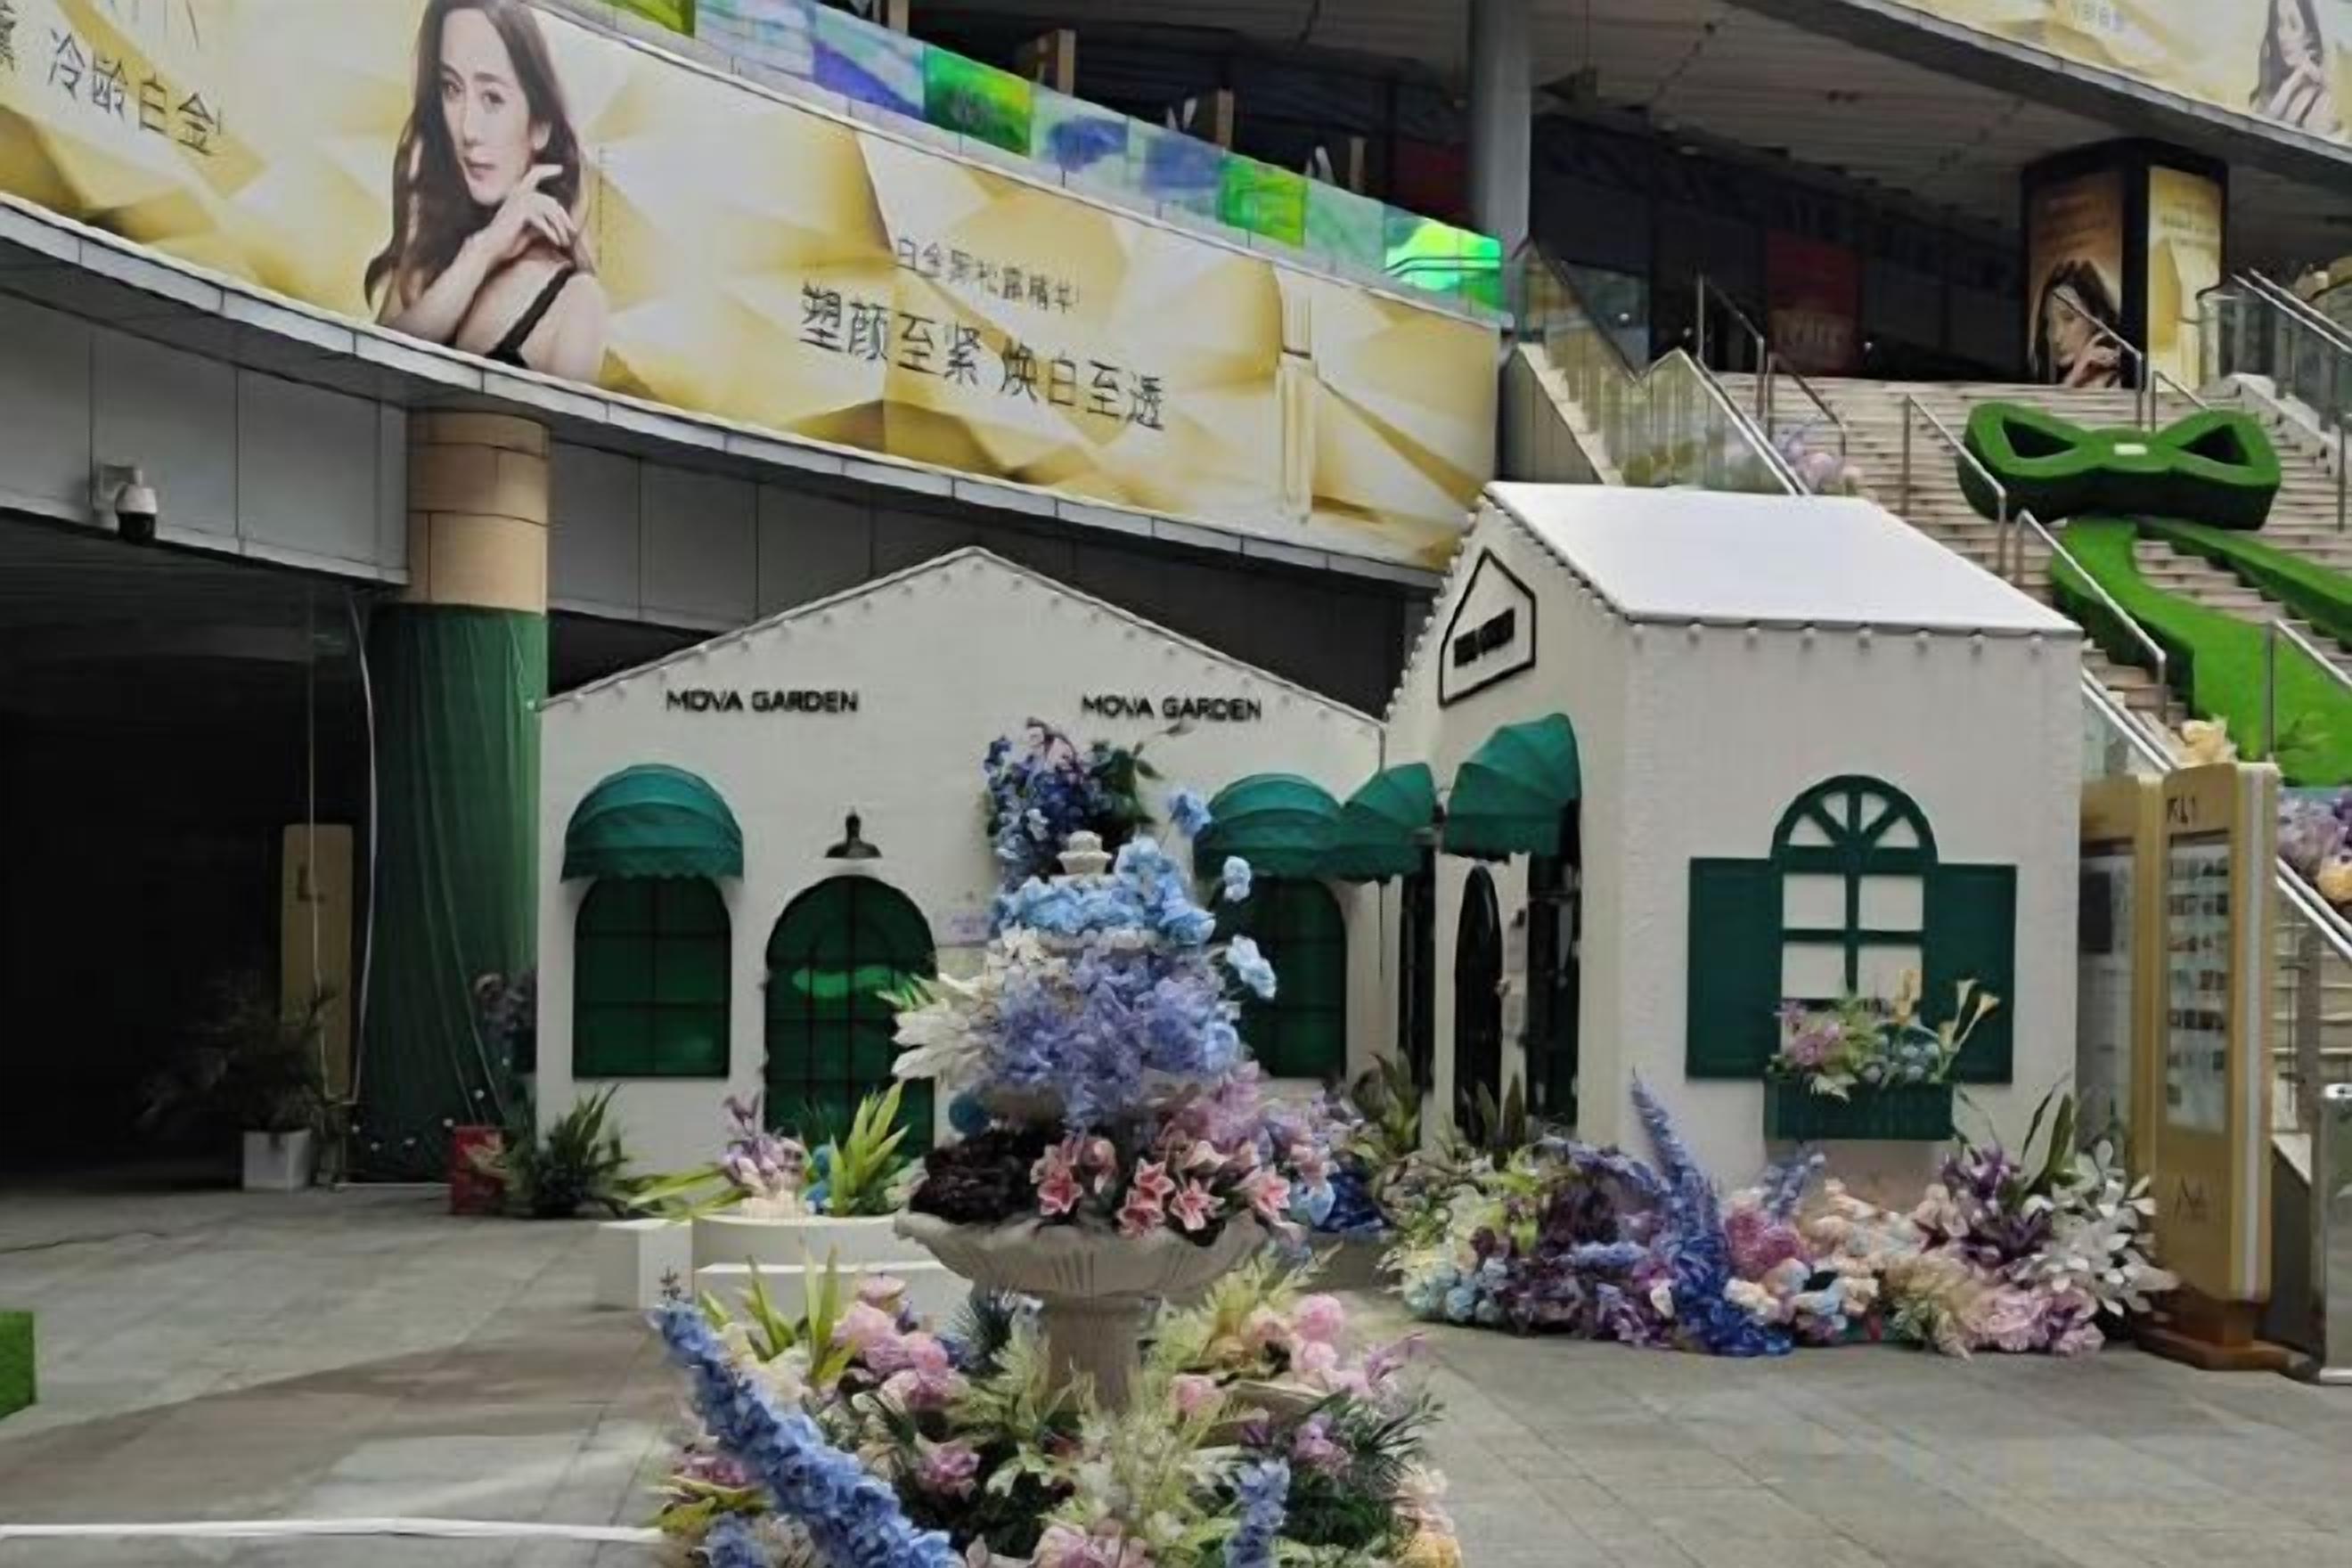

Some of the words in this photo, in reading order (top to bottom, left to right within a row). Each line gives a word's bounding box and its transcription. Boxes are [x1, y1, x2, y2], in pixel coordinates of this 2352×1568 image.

[800, 281, 983, 386] 塑颜至紧
[1000, 337, 1164, 431] 焕白至透
[666, 690, 744, 713] MOVA
[752, 690, 859, 714] GARDEN
[1082, 695, 1155, 719] MOVA
[1162, 697, 1262, 723] GARDEN
